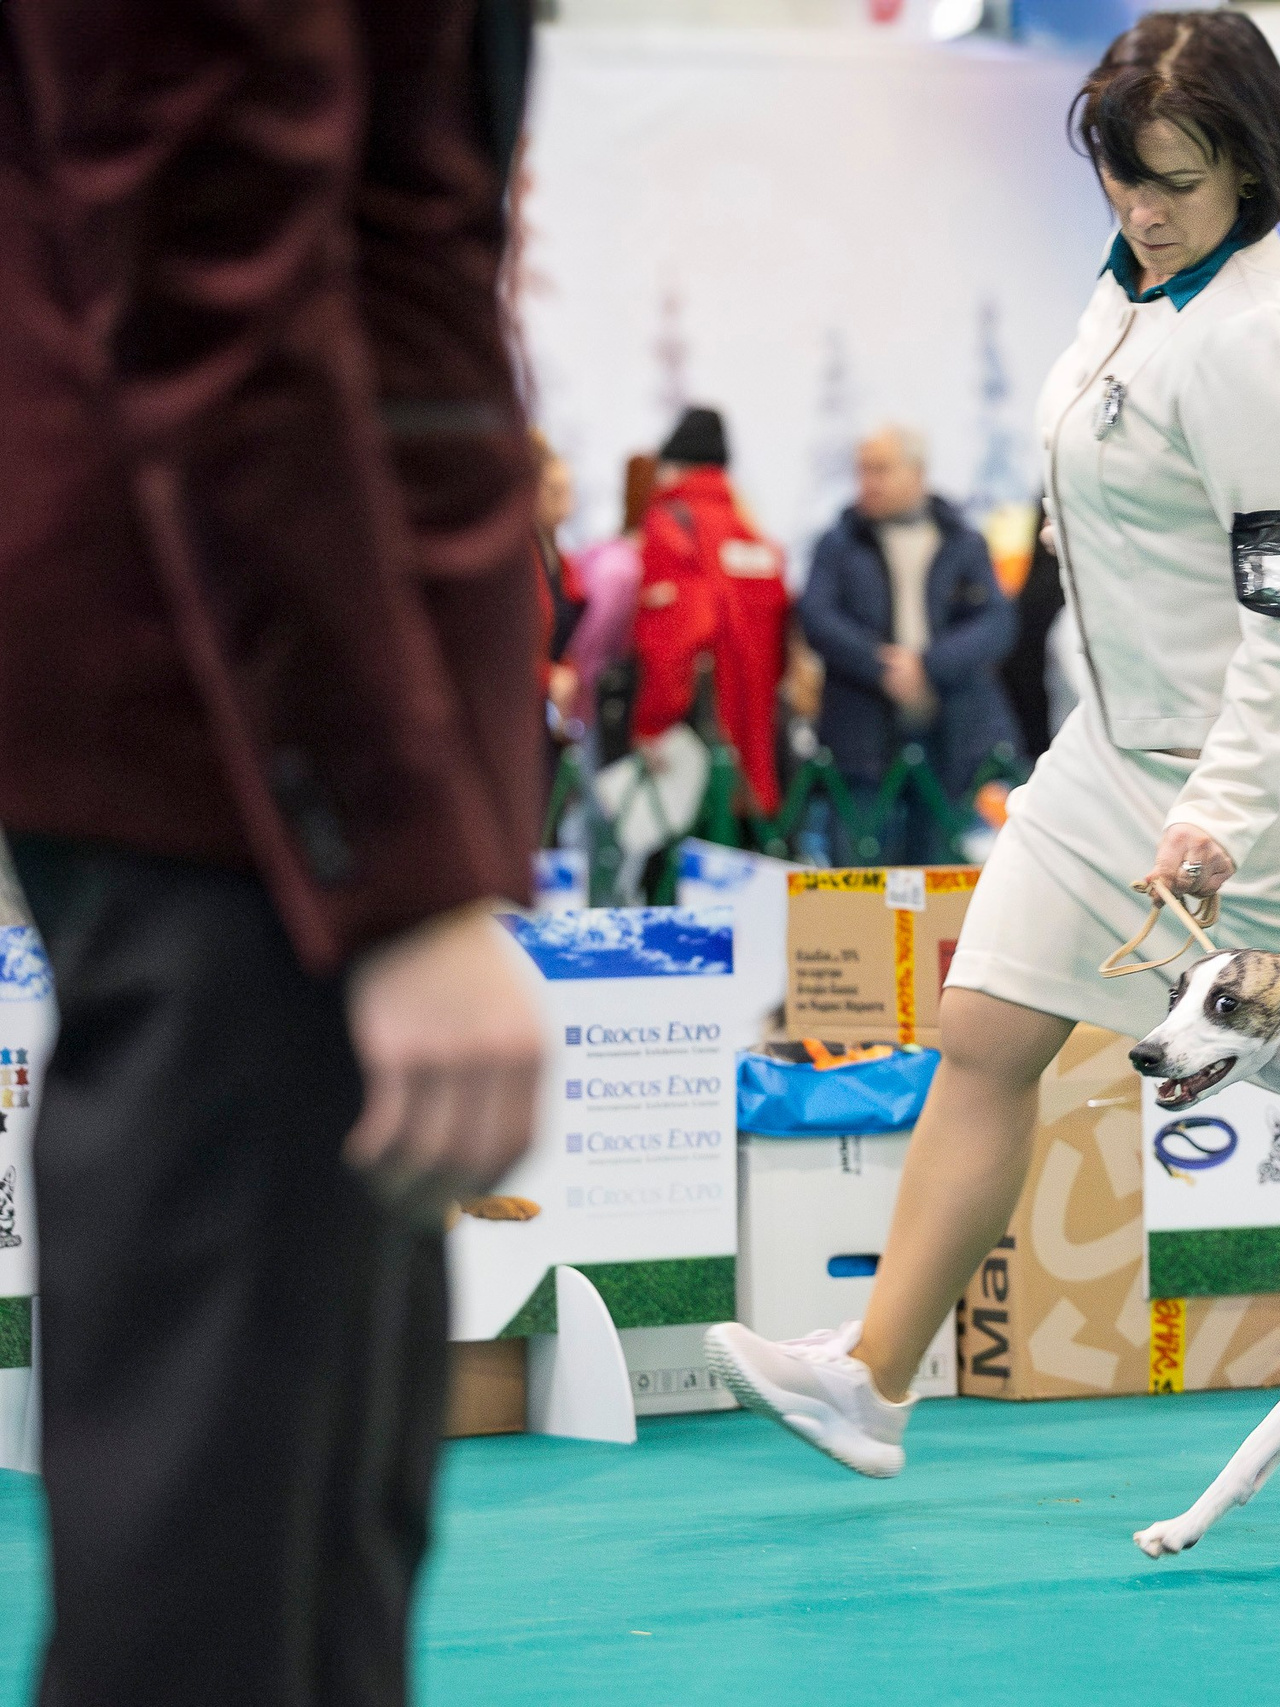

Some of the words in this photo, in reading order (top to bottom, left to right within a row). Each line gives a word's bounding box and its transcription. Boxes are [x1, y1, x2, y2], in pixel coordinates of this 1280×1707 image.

[586, 1024, 660, 1046] CROCUS
[667, 1021, 722, 1042] EXPO
[586, 1078, 661, 1099] CROCUS
[667, 1075, 722, 1096] EXPO
